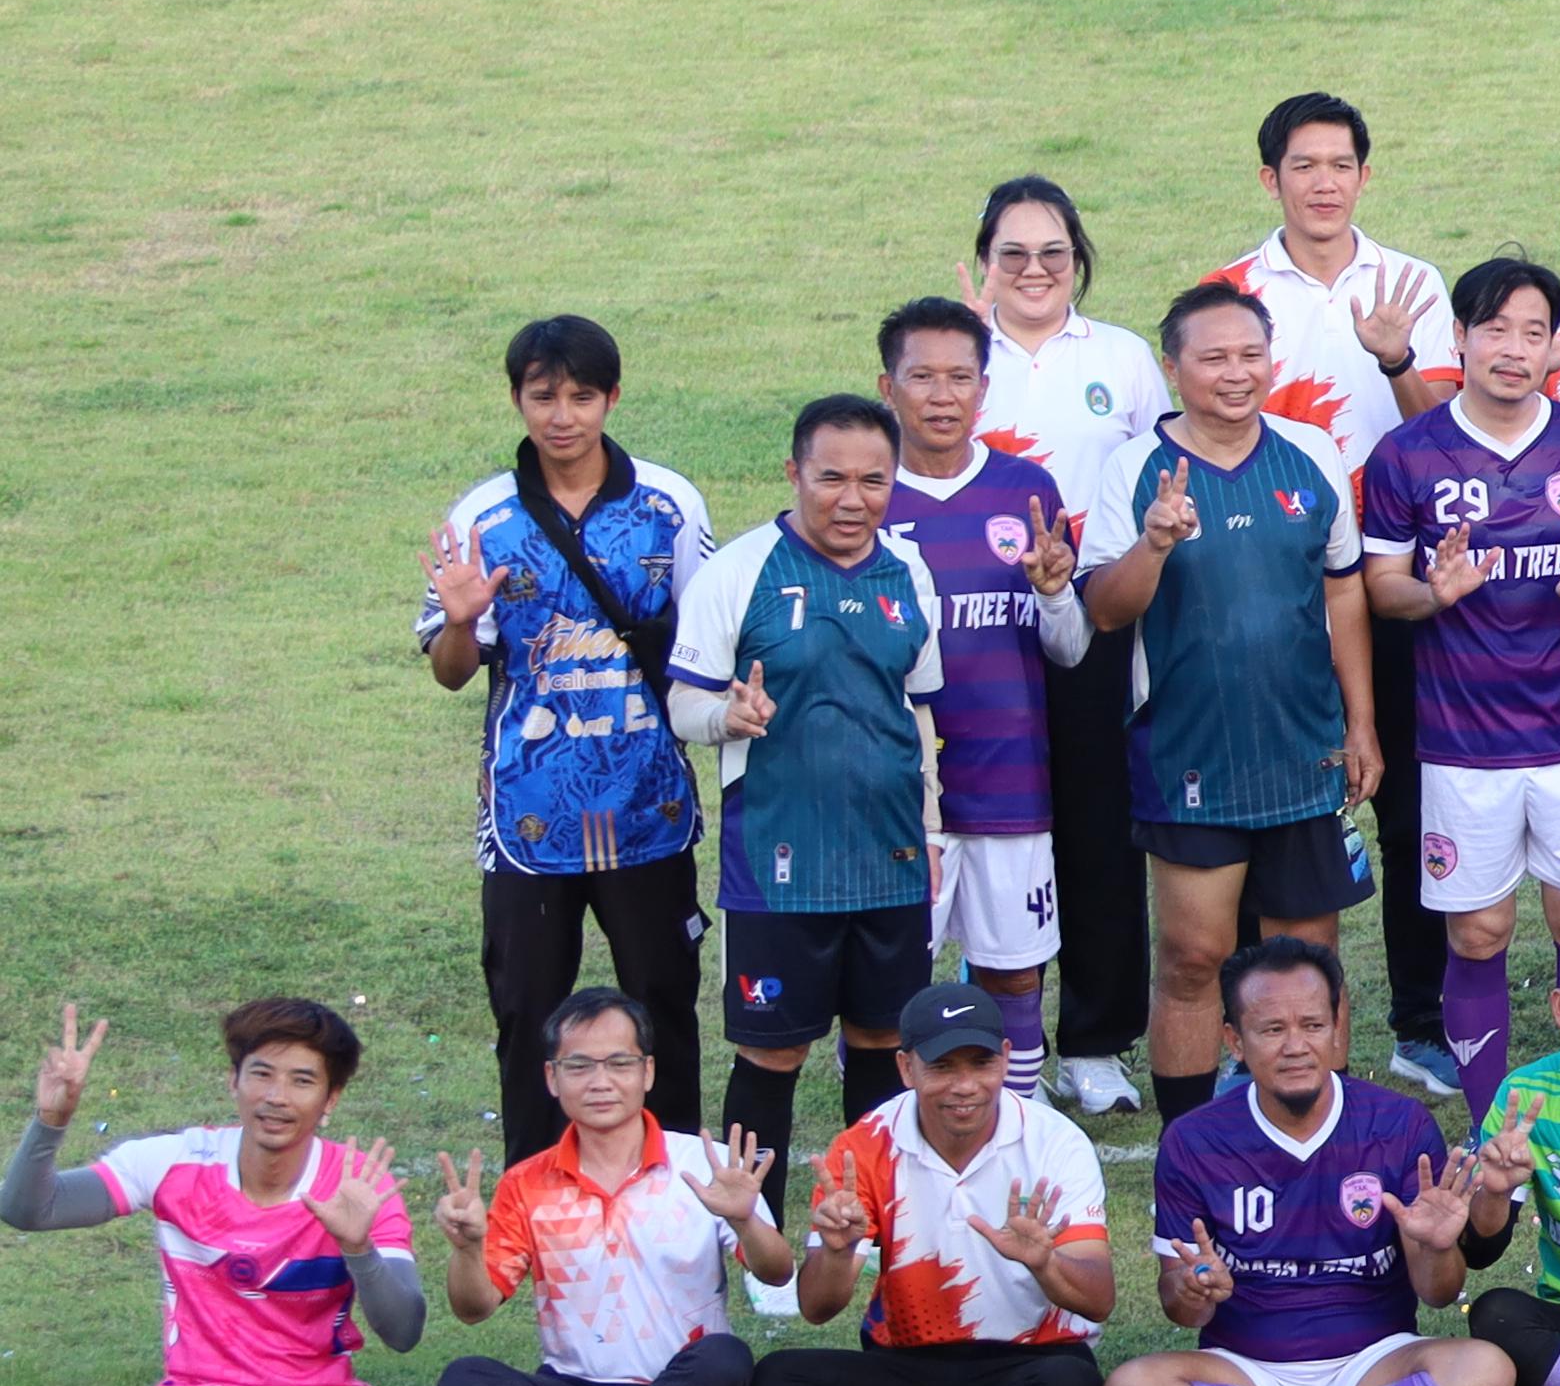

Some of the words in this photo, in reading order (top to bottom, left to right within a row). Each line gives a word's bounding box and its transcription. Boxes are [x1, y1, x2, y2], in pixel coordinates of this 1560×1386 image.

[1434, 477, 1490, 525] 29
[781, 585, 806, 631] 7
[950, 591, 1011, 630] TREE
[1027, 879, 1054, 931] 45
[1234, 1185, 1275, 1235] 10
